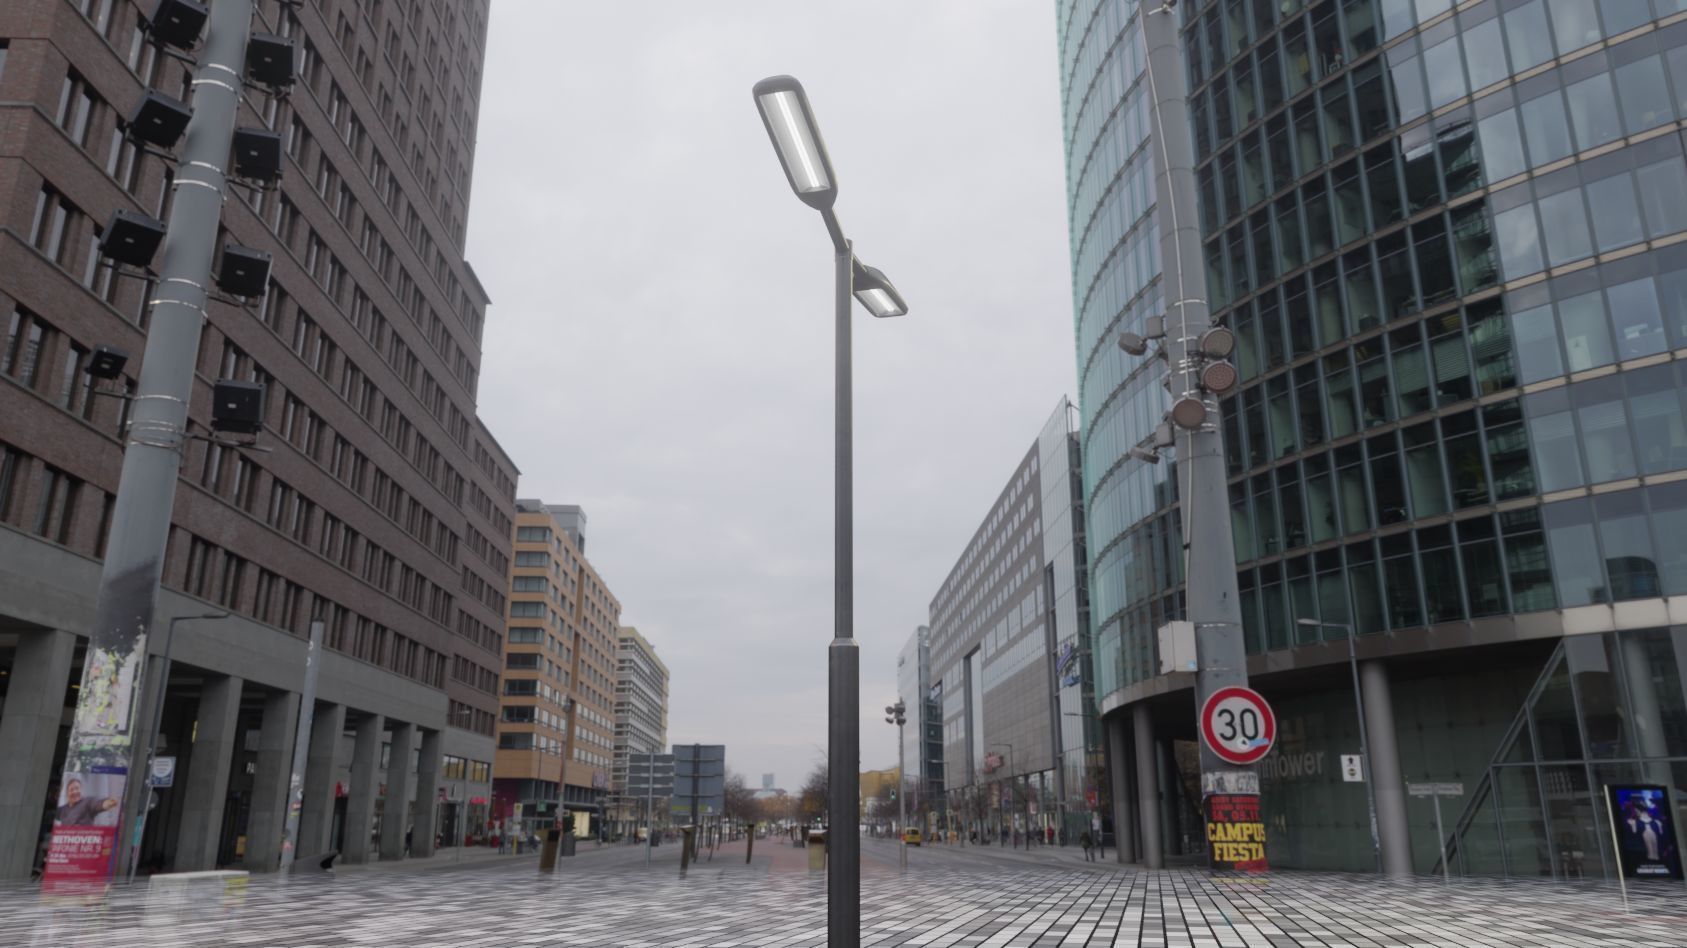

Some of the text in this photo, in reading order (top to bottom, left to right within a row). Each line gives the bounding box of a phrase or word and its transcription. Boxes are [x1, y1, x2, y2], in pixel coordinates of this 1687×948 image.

[1218, 709, 1259, 741] 30
[1207, 822, 1266, 842] CAMPUS
[1213, 842, 1265, 861] FIESTA
